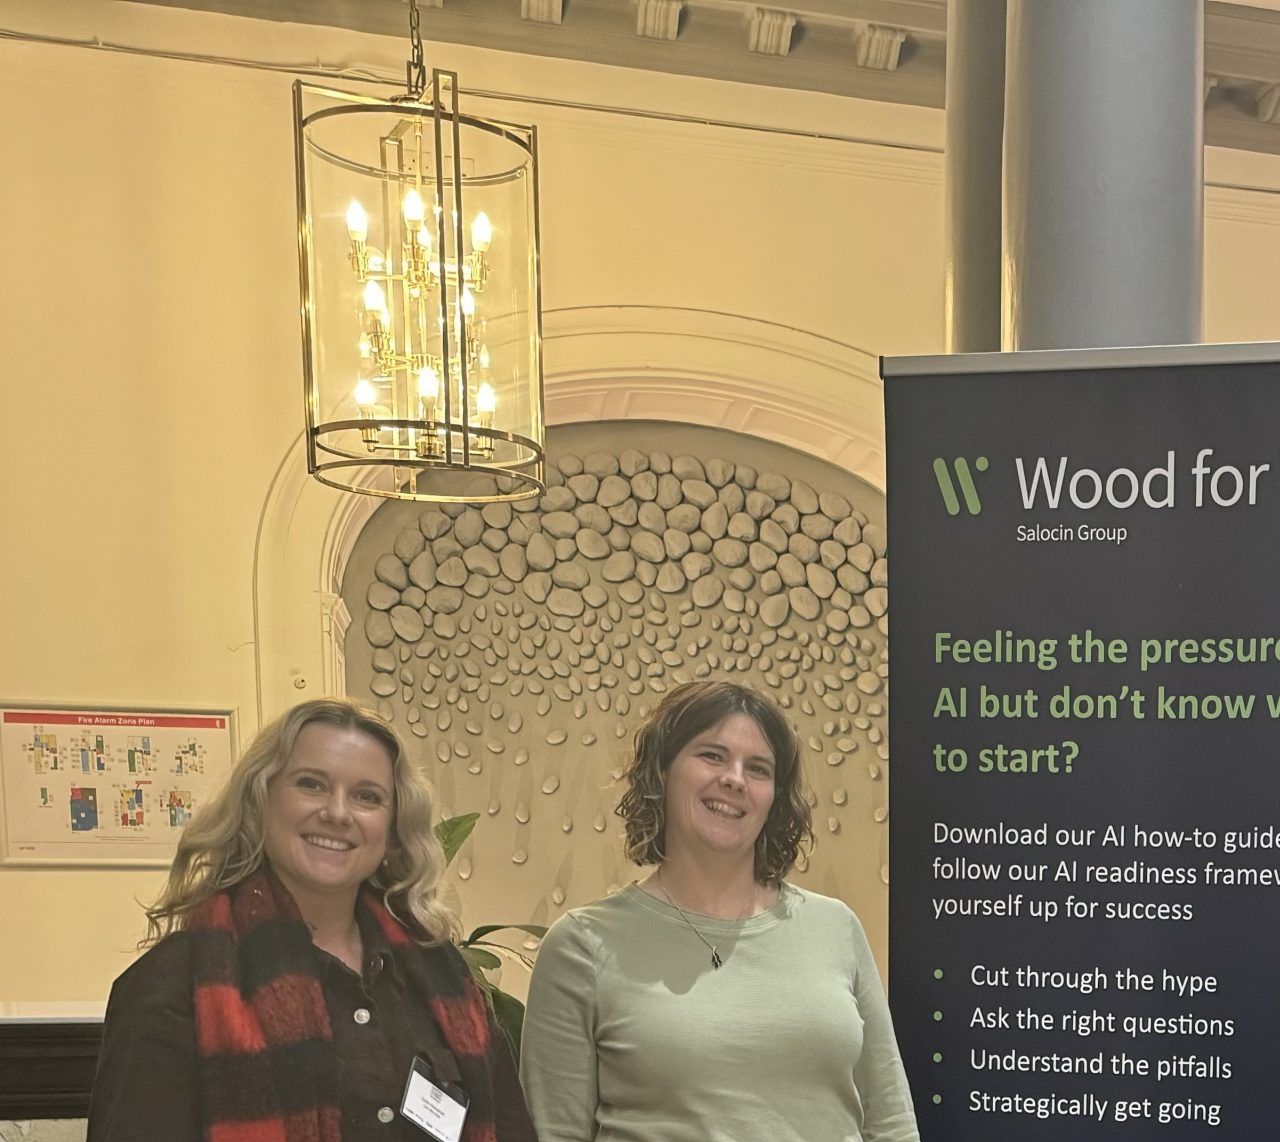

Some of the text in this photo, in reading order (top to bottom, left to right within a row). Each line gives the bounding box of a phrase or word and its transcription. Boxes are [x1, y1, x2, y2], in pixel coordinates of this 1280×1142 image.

[1015, 450, 1175, 510] Wood
[1191, 448, 1269, 507] for
[1016, 523, 1128, 545] Salocin Group
[935, 629, 1058, 671] Feeling
[1067, 629, 1128, 664] the
[933, 687, 967, 718] AI
[980, 685, 1039, 719] but
[1049, 685, 1146, 720] don’t
[1157, 685, 1256, 720] know
[78, 716, 156, 726] Fire Alarm Zone Plan
[932, 740, 1080, 774] to start?
[934, 821, 1048, 846] Download
[1055, 829, 1096, 846] our
[1101, 825, 1125, 847] AI
[1134, 824, 1217, 848] how-to
[932, 856, 1002, 880] follow
[1008, 864, 1049, 882] our
[1054, 860, 1077, 882] AI
[1086, 860, 1197, 885] readiness
[932, 893, 1193, 922] yourself up for success
[971, 964, 1217, 997] Cut through the hype
[969, 1006, 1235, 1038] Ask the right questions
[971, 1048, 1232, 1081] Understand the pitfalls
[969, 1090, 1221, 1126] Strategically get going
